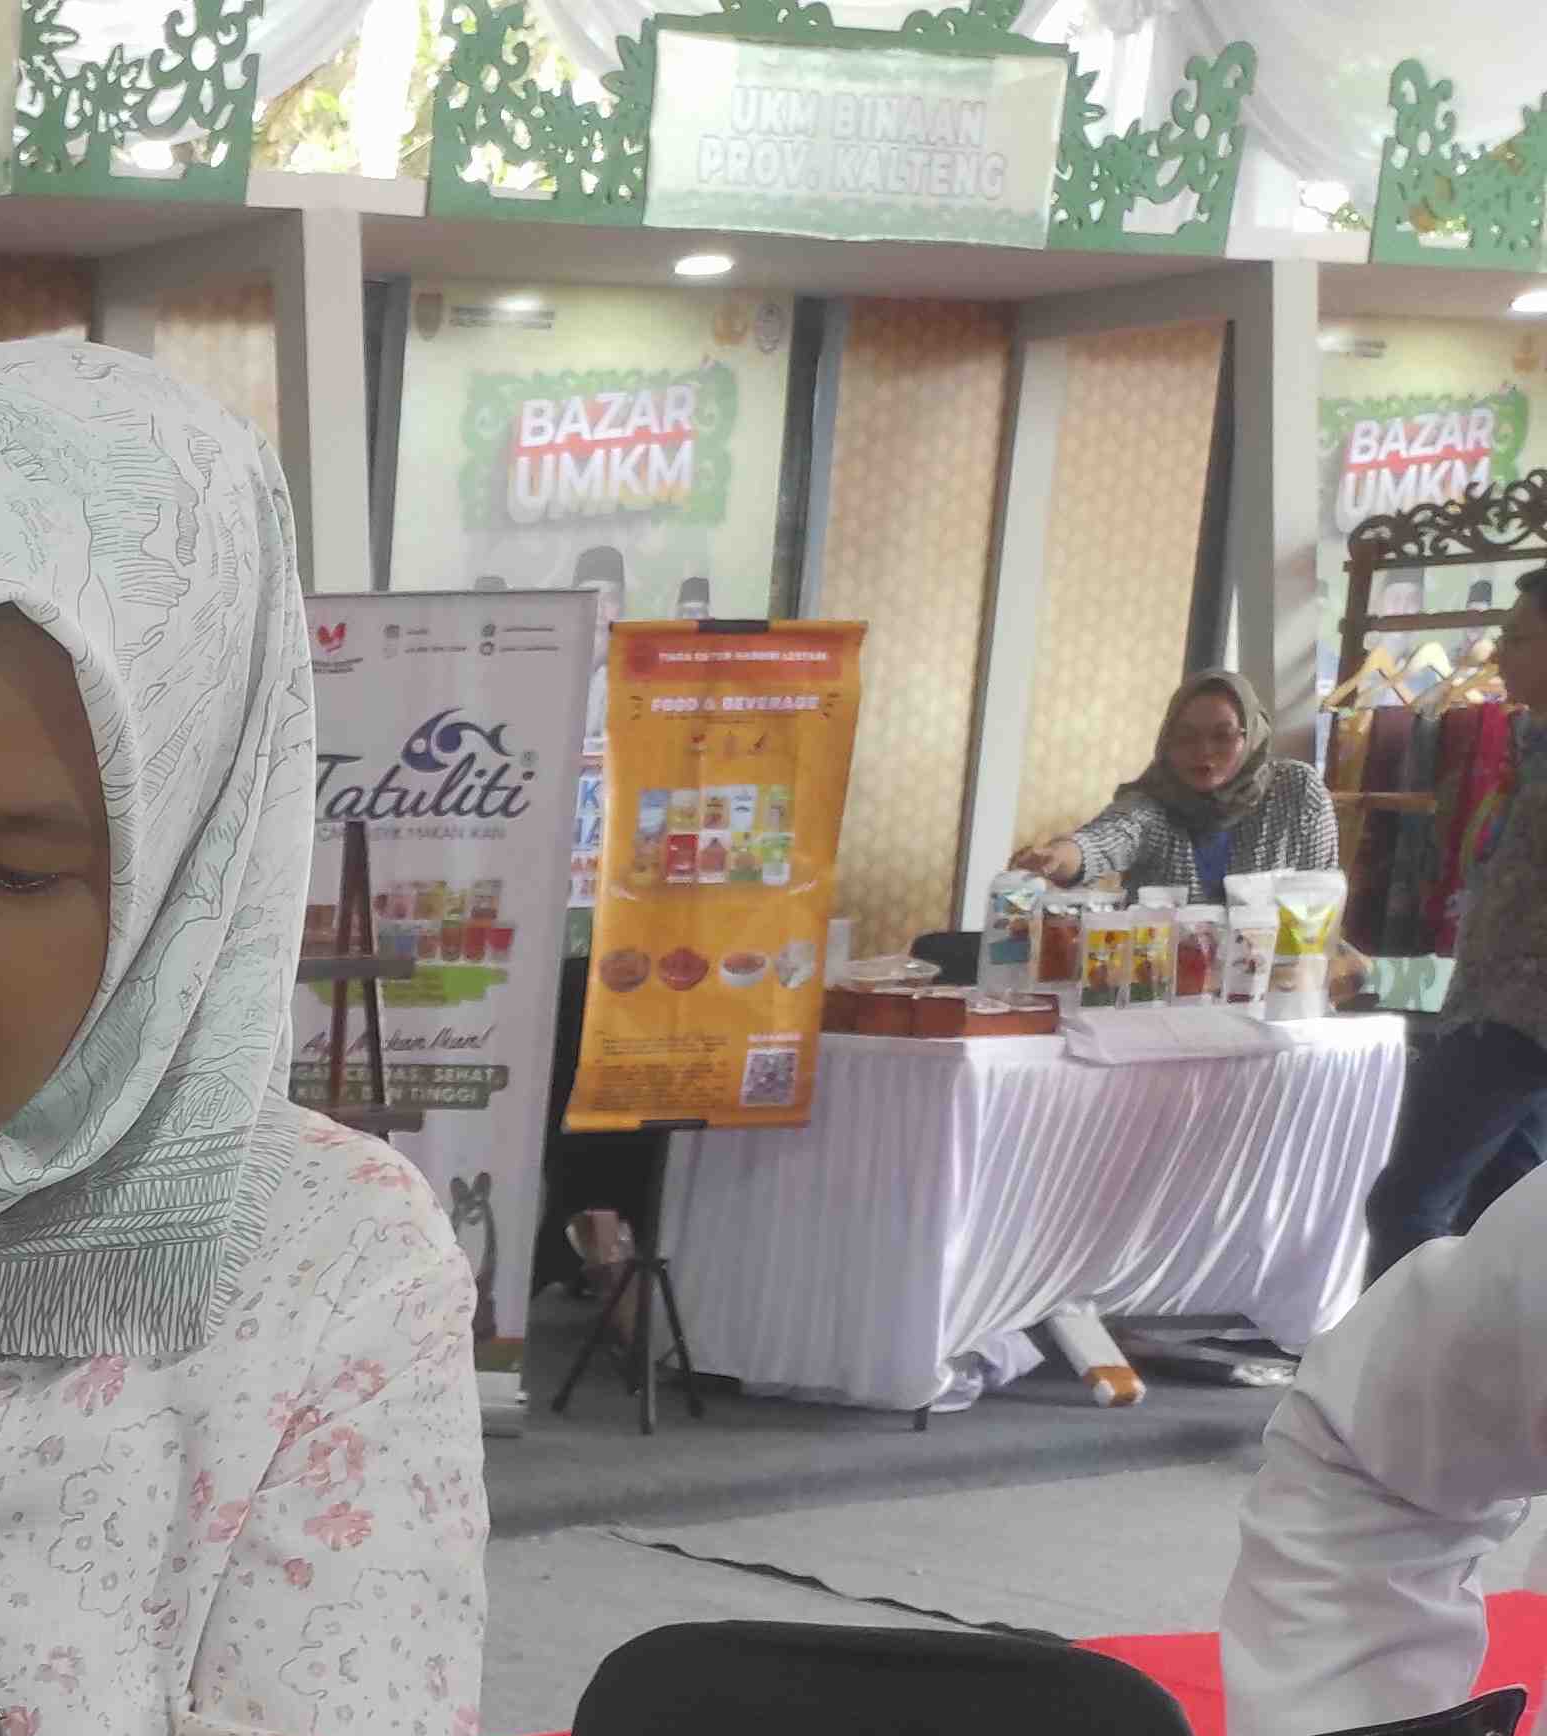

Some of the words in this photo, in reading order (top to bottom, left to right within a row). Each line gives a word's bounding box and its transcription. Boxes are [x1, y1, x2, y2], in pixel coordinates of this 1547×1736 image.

[731, 85, 821, 138] UKM
[829, 90, 987, 149] BINAAN
[697, 134, 821, 190] PROV.
[834, 144, 1007, 200] KALTENG
[521, 384, 694, 448] BAZAR
[1349, 407, 1494, 465] BAZAR
[516, 440, 694, 508] UMKM
[1339, 457, 1492, 520] UMKM
[315, 752, 535, 819] Tatuliti
